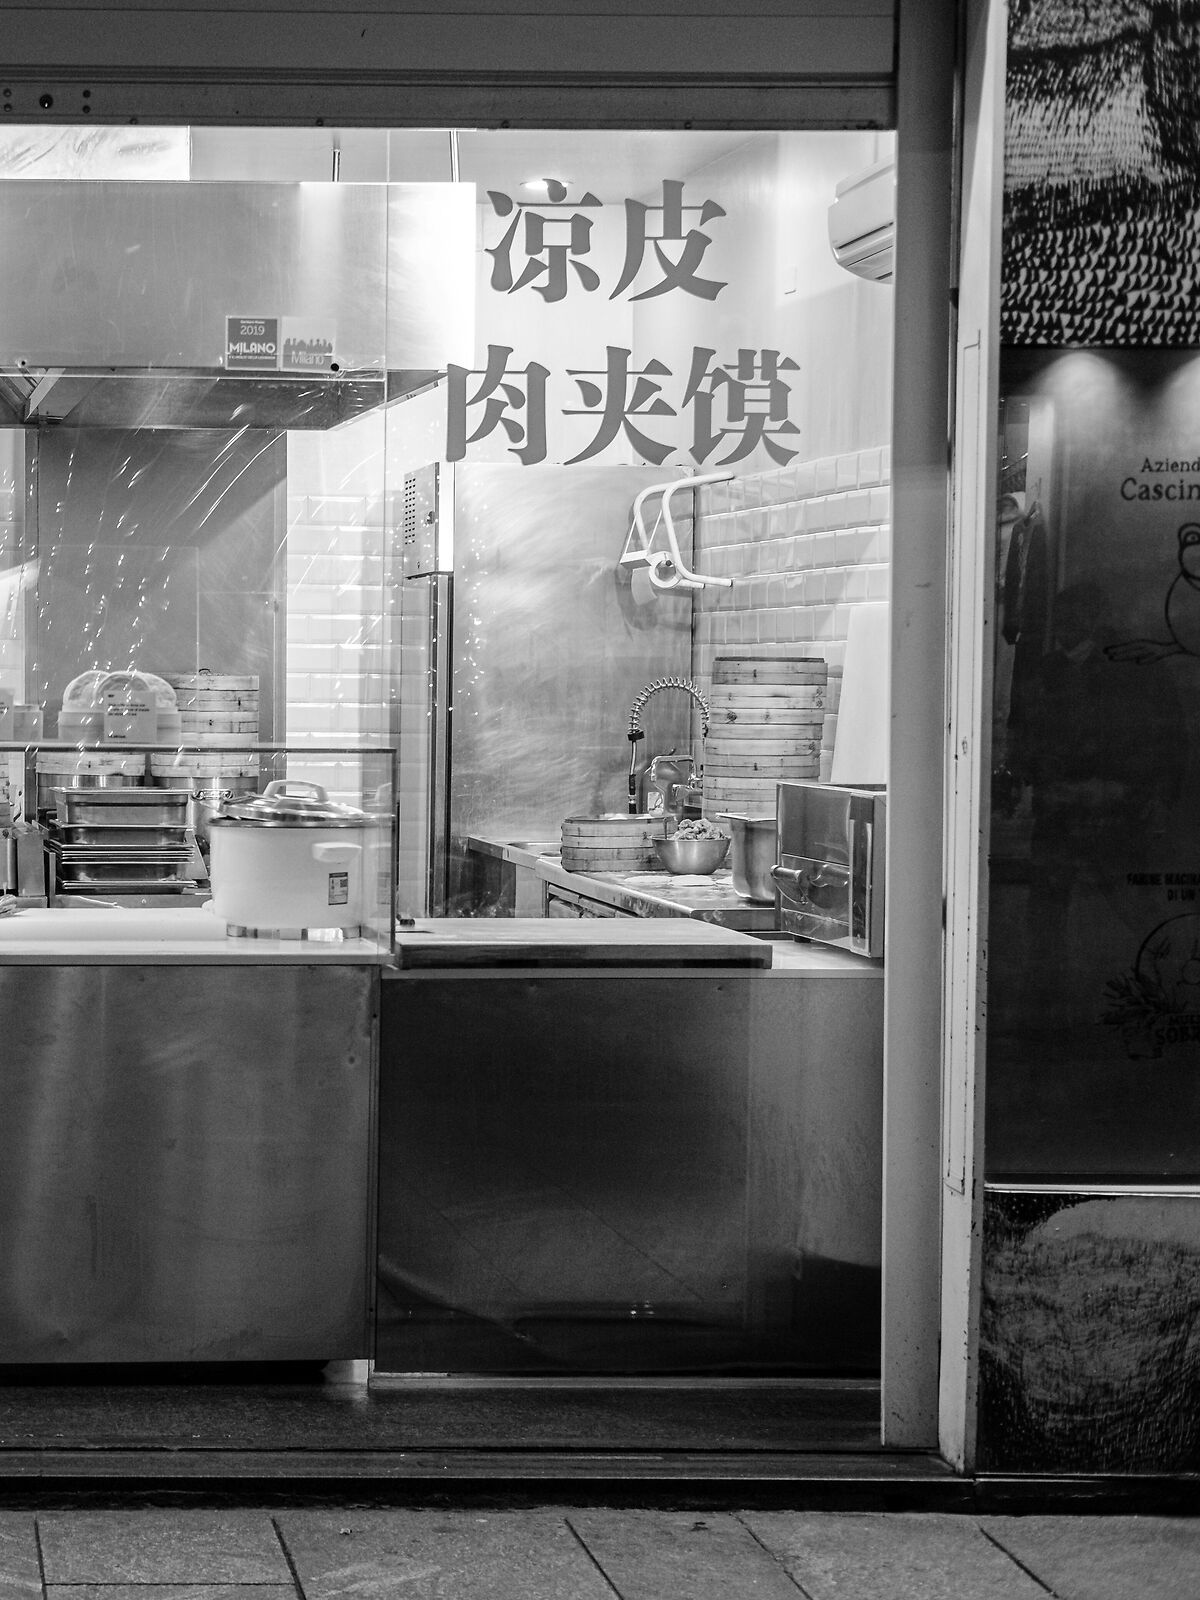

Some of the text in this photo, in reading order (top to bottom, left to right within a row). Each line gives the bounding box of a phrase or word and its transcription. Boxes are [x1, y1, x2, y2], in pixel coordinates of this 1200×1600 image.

[484, 178, 728, 303] 凉皮
[240, 325, 265, 336] 2019
[229, 342, 276, 354] MILANO
[291, 351, 325, 365] Milano
[446, 344, 801, 467] 肉夹馍
[1141, 457, 1200, 473] Aziend
[1120, 477, 1200, 501] Cascin
